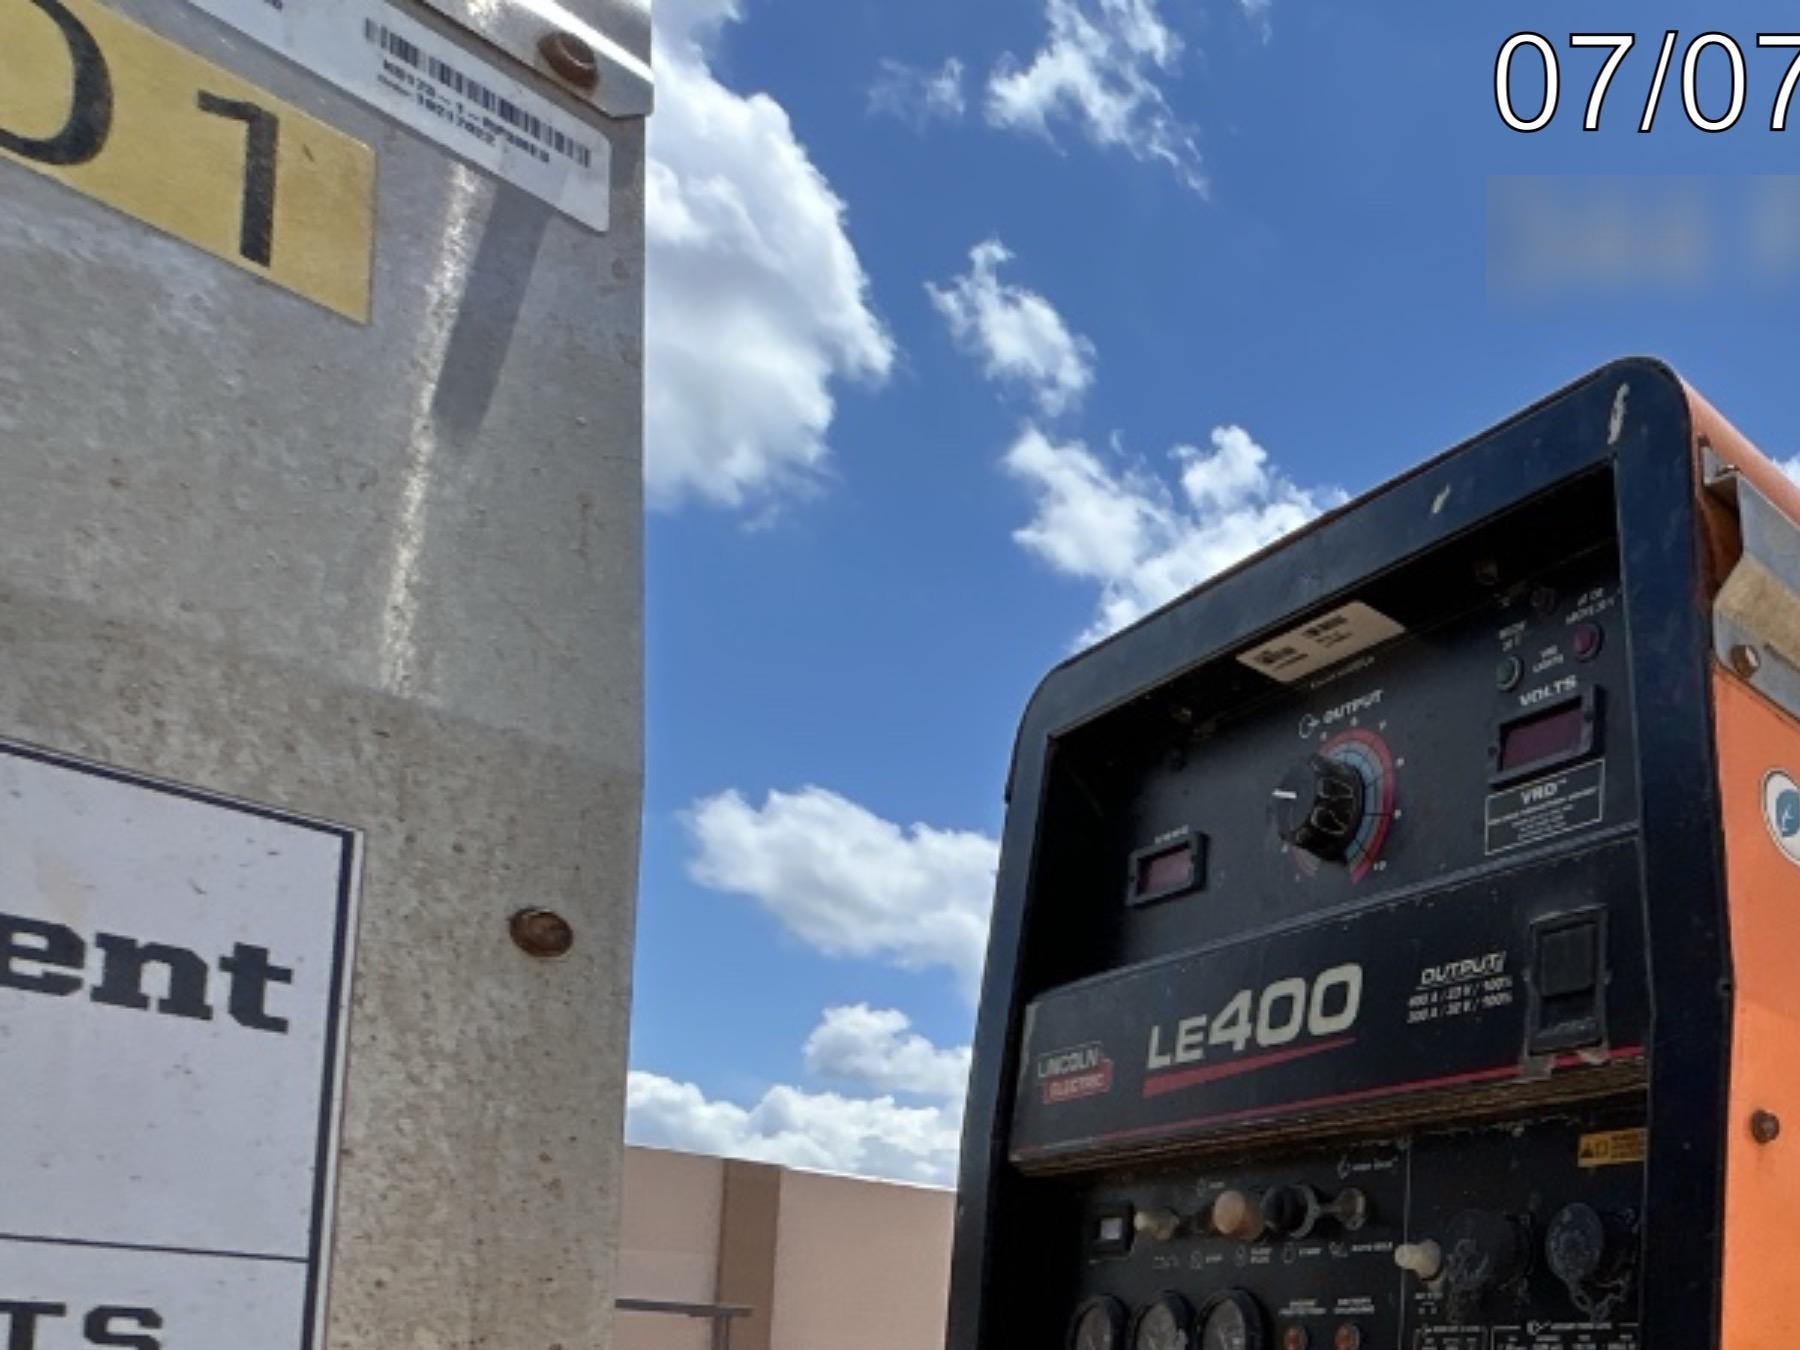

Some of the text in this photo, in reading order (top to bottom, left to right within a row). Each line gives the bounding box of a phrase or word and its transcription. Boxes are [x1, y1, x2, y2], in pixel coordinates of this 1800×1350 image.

[1519, 674, 1577, 706] VOLTS
[1146, 963, 1364, 1070] LE400
[1037, 1046, 1099, 1078] LINCOLN
